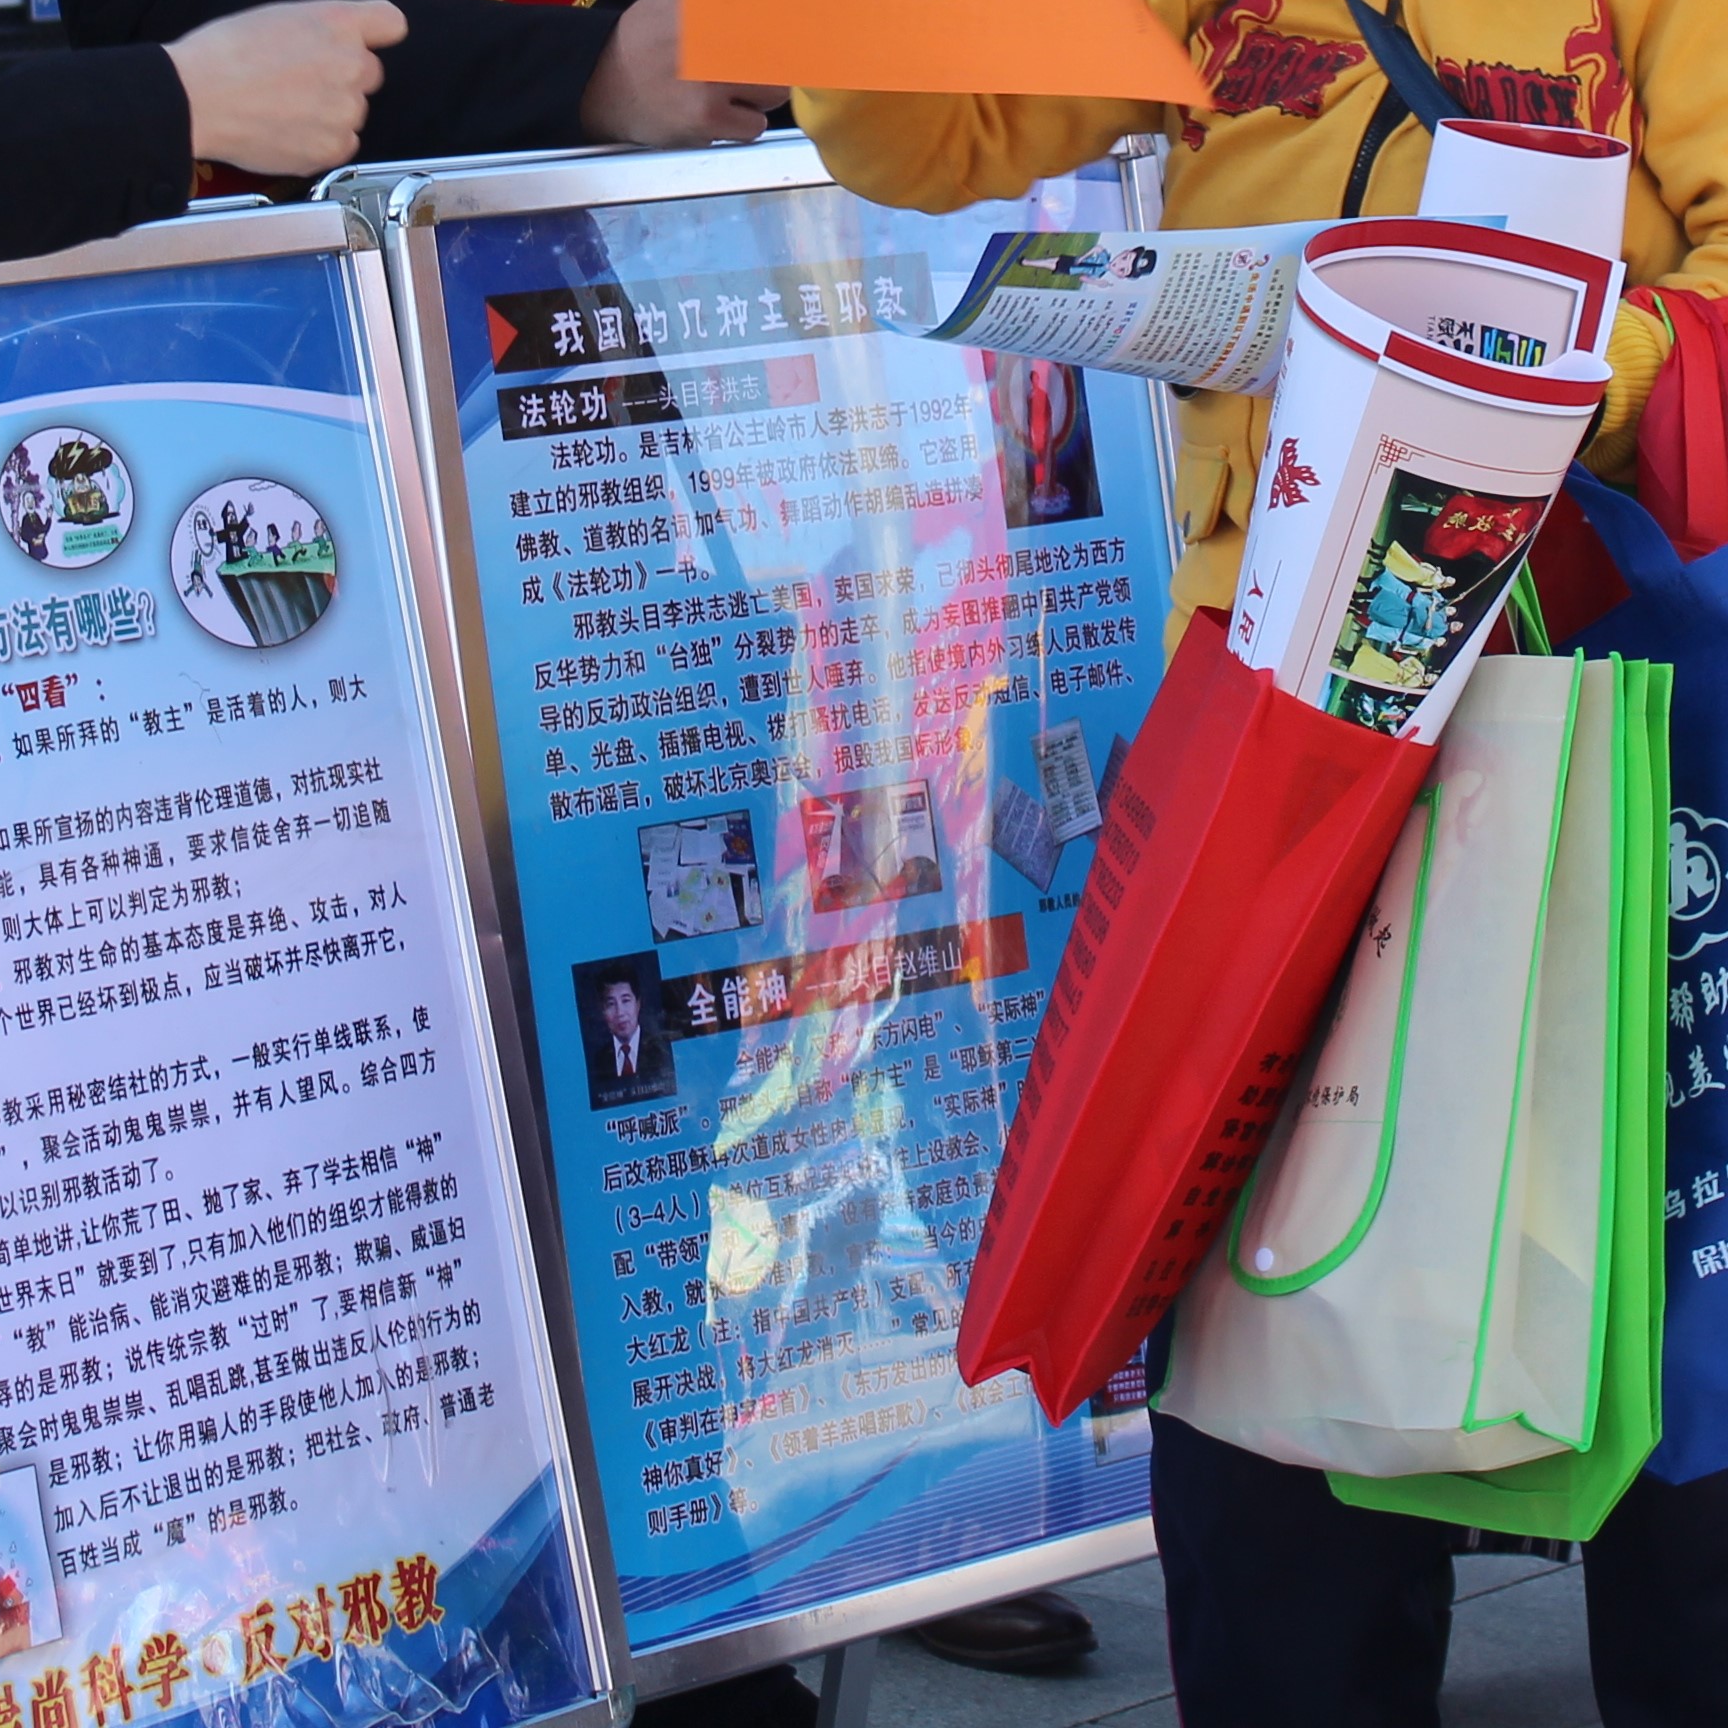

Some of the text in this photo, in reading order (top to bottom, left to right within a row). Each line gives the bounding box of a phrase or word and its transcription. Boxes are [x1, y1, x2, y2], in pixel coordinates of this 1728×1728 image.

[549, 272, 906, 358] 我国的几种主要邪教
[517, 383, 609, 431] 法轮功
[684, 967, 789, 1028] 全能神
